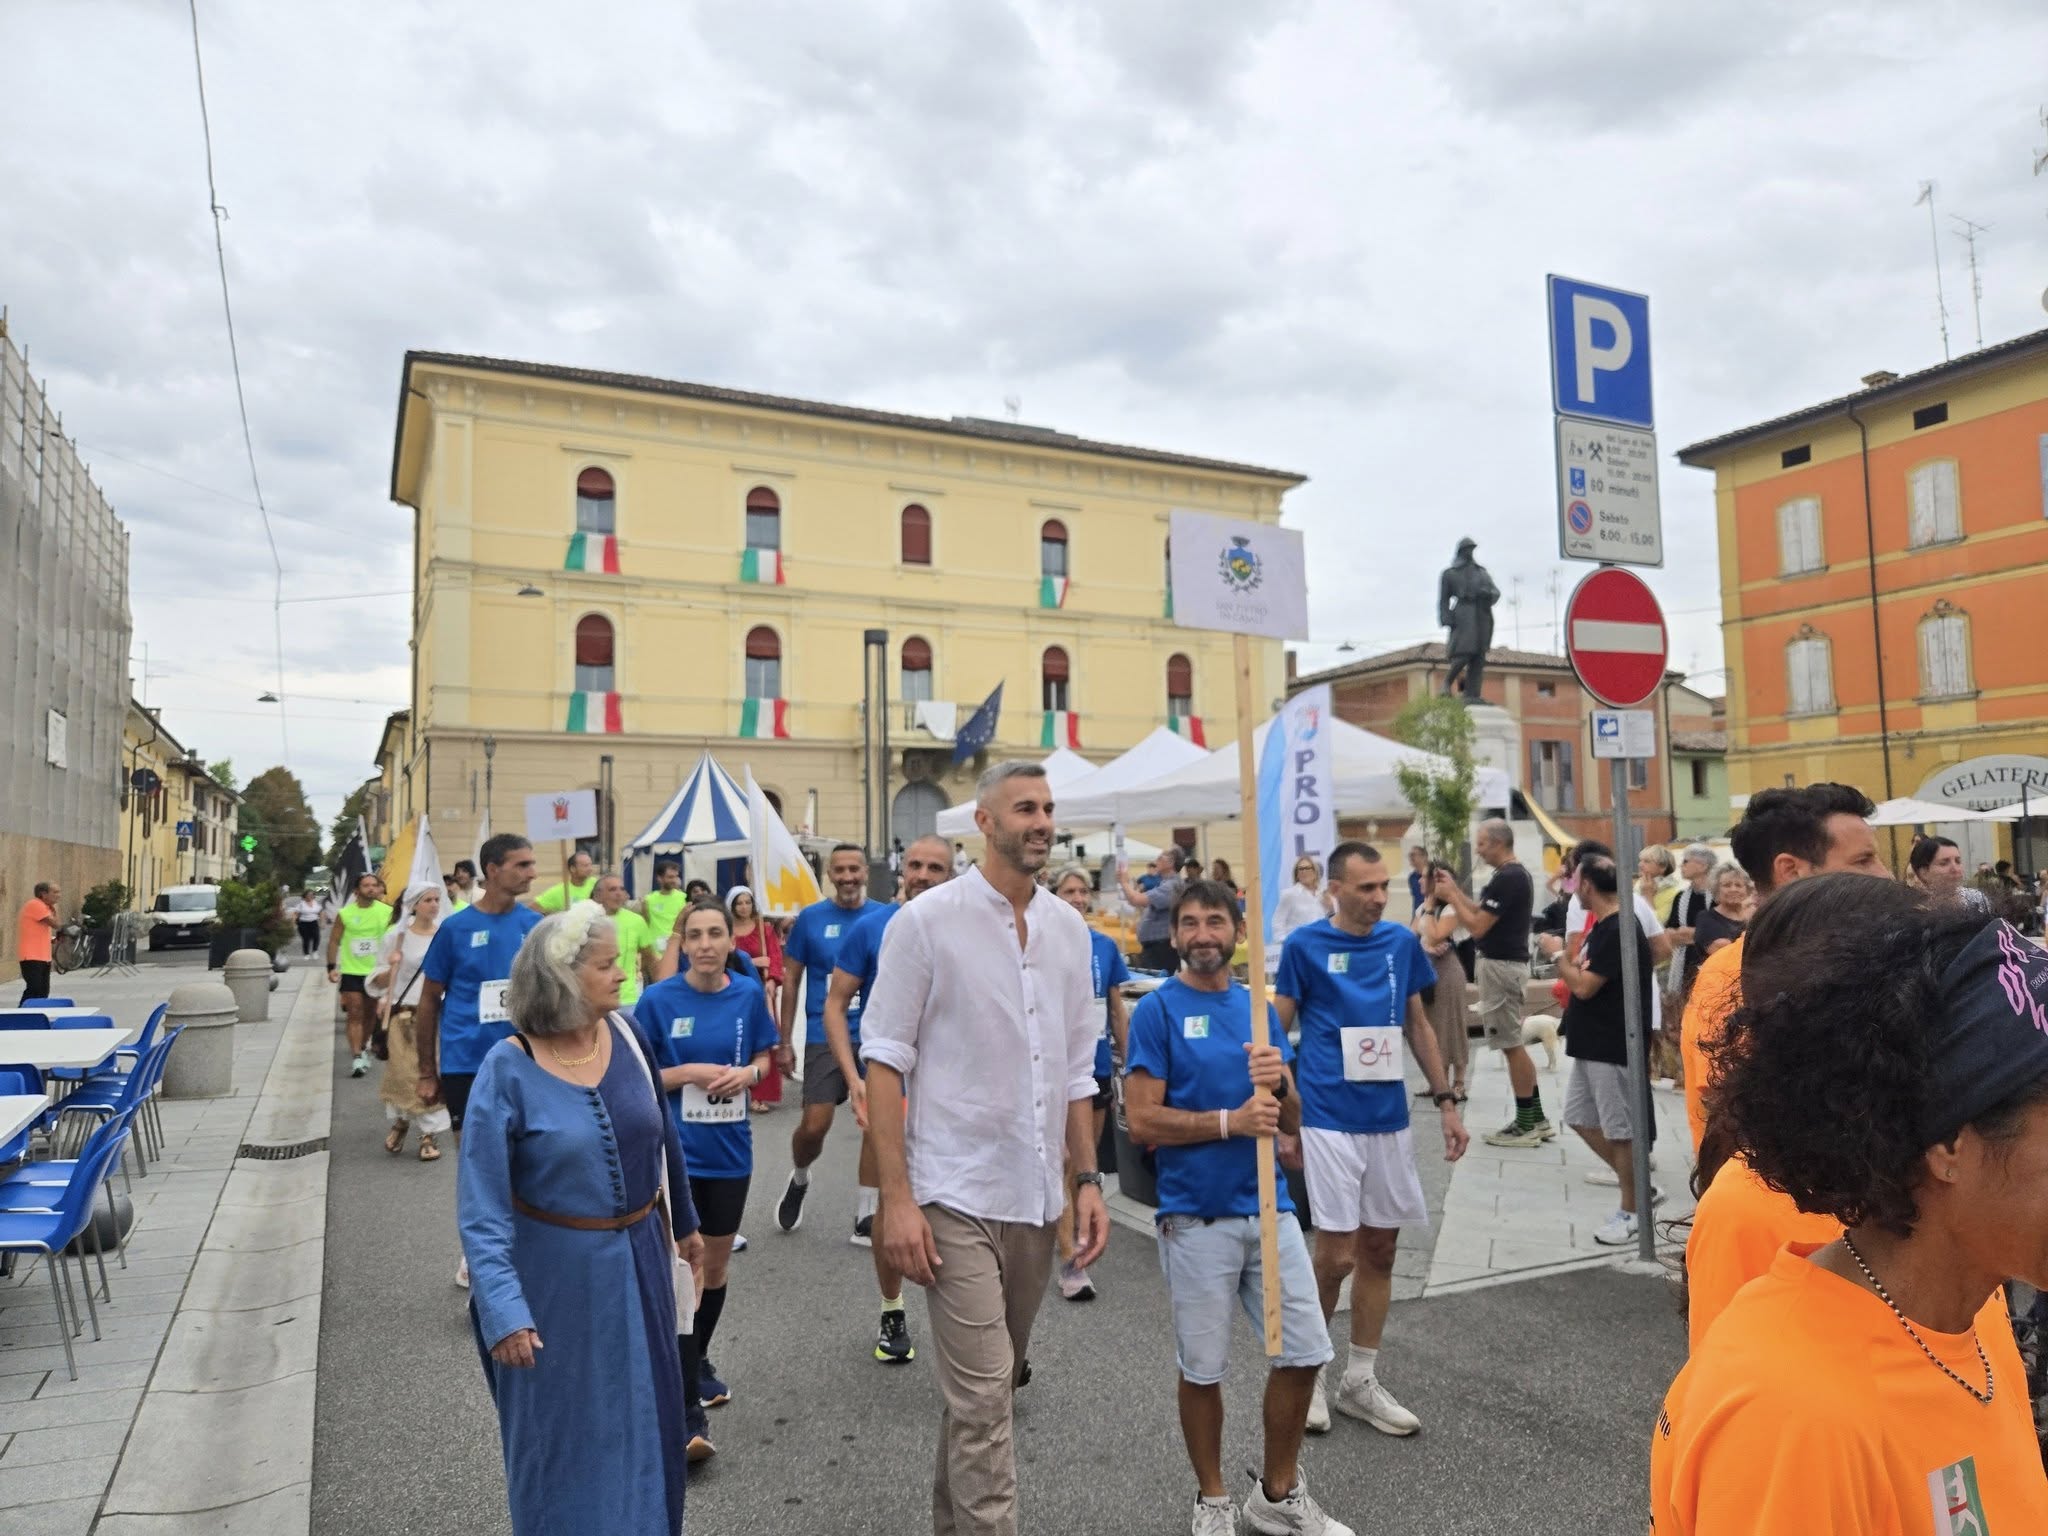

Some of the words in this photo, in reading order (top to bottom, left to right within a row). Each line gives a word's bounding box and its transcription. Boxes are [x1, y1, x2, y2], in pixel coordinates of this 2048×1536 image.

[1572, 292, 1633, 404] P
[1599, 511, 1629, 525] Sabato
[1359, 1038, 1392, 1067] 84
